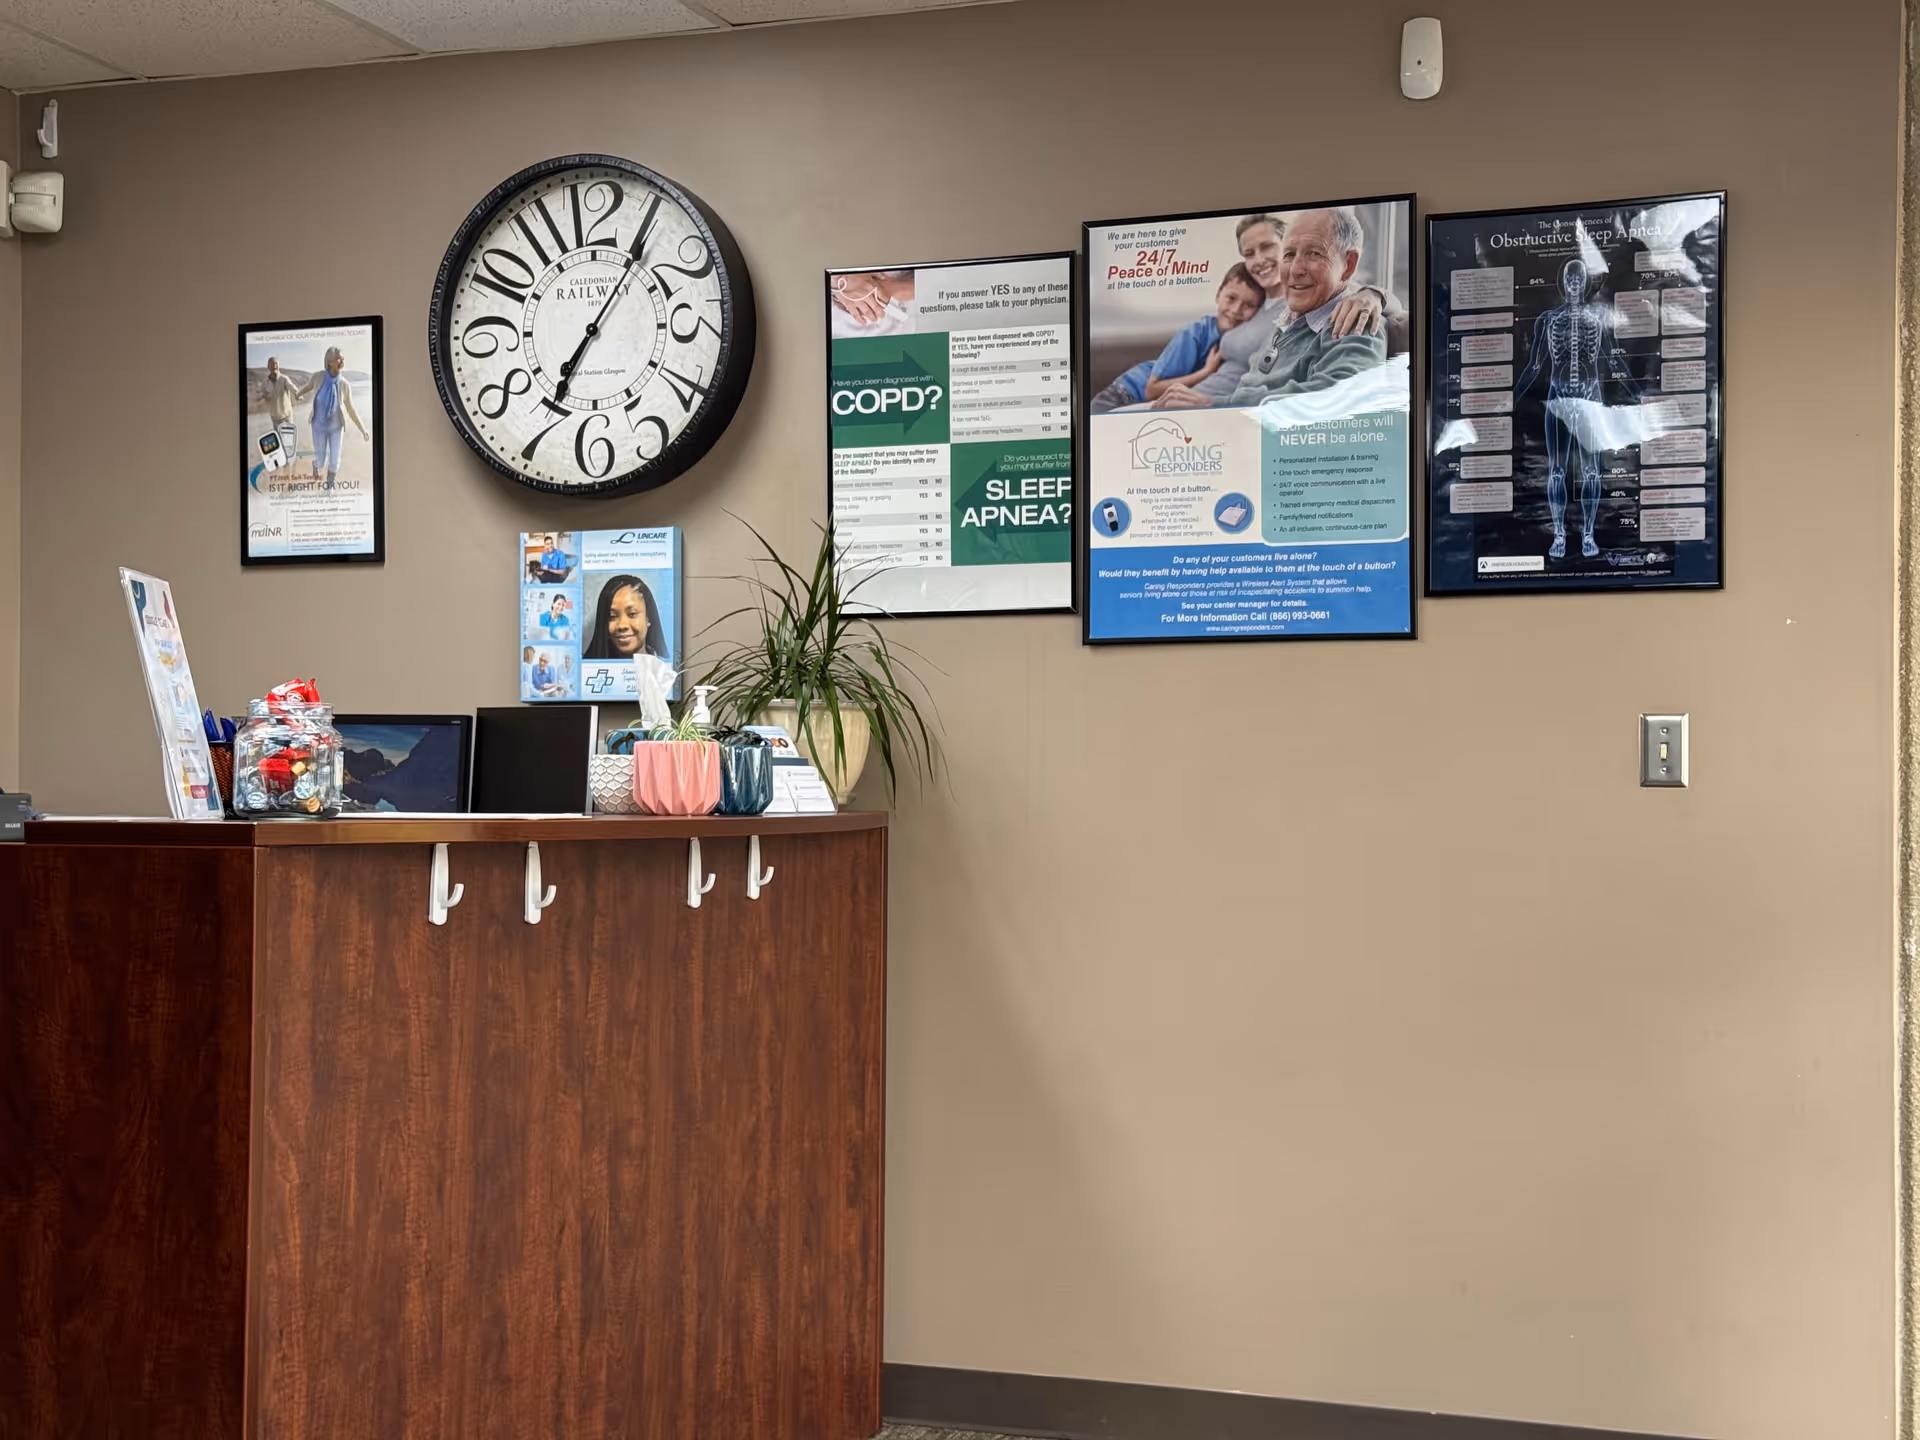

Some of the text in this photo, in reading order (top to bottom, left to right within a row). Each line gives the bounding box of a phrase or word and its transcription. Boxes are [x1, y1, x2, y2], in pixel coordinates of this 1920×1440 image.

[562, 180, 624, 248] 12
[1538, 220, 1551, 230] The
[1604, 216, 1612, 224] of
[508, 193, 575, 270] 11
[624, 191, 670, 260] 1
[1108, 232, 1120, 240] We
[1137, 230, 1156, 238] here
[1170, 228, 1186, 238] give
[1114, 238, 1178, 252] your customers
[1490, 224, 1661, 248] Obstructive Sleep Apnea
[1136, 248, 1176, 266] 24/7
[651, 236, 714, 301] 2
[1108, 260, 1209, 280] Peace of Mind
[469, 249, 534, 308] 10
[570, 276, 618, 286] CALEDONIAN
[1118, 280, 1130, 288] the
[1132, 278, 1156, 288] touch
[1159, 278, 1167, 286] of
[938, 291, 944, 300] If
[946, 292, 960, 300] you
[990, 284, 1010, 296] YES
[1012, 286, 1020, 294] to
[1022, 286, 1036, 294] any
[1038, 284, 1046, 292] of
[1048, 283, 1068, 291] these
[920, 296, 1068, 314] questions, please talk to your physician.
[670, 299, 722, 344] 3
[462, 316, 520, 359] 9
[992, 332, 1021, 340] diagnosed
[996, 340, 1030, 349] experienced
[658, 360, 708, 413] 4
[852, 380, 864, 388] you
[883, 376, 918, 385] diagnosed
[478, 368, 531, 419] 8
[832, 385, 943, 416] COPD?
[521, 396, 572, 461] 7
[624, 394, 670, 461] 5
[1306, 418, 1370, 430] customers
[1373, 414, 1393, 426] will
[575, 414, 615, 478] 6
[1280, 432, 1387, 446] NEVER be alone.
[1144, 444, 1222, 463] CARING
[1014, 462, 1034, 471] might
[1155, 461, 1222, 473] RESPONDERS
[269, 484, 276, 492] IS
[278, 484, 286, 492] IT
[288, 482, 315, 492] RIGHT
[318, 482, 335, 490] FOR
[986, 477, 1071, 500] SLEEP
[960, 503, 1071, 528] APNEA?
[1173, 556, 1184, 564] Do
[1186, 557, 1199, 565] any
[1202, 555, 1210, 563] of
[1212, 556, 1229, 564] your
[1231, 554, 1272, 562] customers
[1290, 552, 1317, 560] alone?
[1099, 569, 1122, 578] Would
[1124, 569, 1140, 578] they
[1142, 568, 1169, 577] benefit
[1171, 568, 1180, 577] by
[1182, 567, 1207, 576] having
[1210, 566, 1226, 576] help
[1228, 566, 1263, 574] available
[1275, 564, 1295, 572] them
[1297, 564, 1306, 572] at
[1307, 564, 1320, 572] the
[1322, 563, 1345, 571] touch
[1347, 562, 1357, 570] of
[1364, 561, 1396, 570] button?
[1161, 614, 1174, 623] For
[1178, 614, 1198, 622] More
[1201, 612, 1248, 622] Information
[1251, 610, 1267, 620] Call
[1270, 610, 1290, 622] (866)
